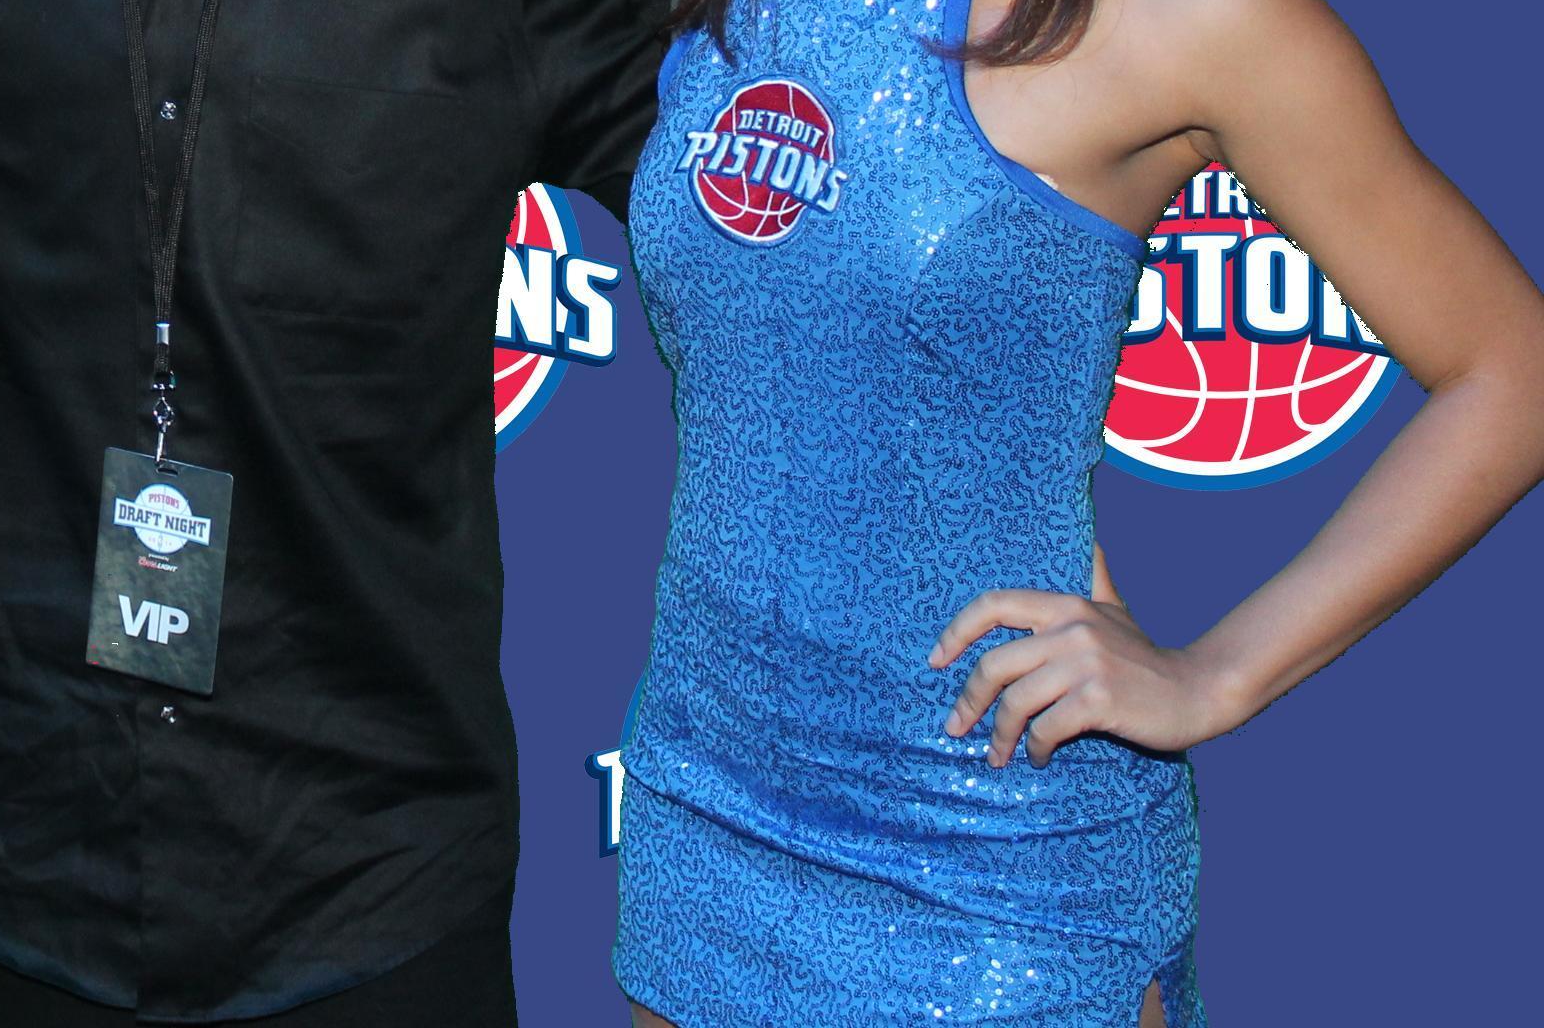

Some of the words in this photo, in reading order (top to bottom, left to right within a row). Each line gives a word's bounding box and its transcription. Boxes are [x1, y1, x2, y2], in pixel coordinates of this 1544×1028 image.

[738, 109, 825, 149] DETROIT
[676, 130, 849, 213] PISTONS
[118, 503, 162, 527] DRAFT
[164, 515, 207, 538] NIGHT
[148, 493, 180, 509] PISTONS
[118, 594, 190, 645] VIP
